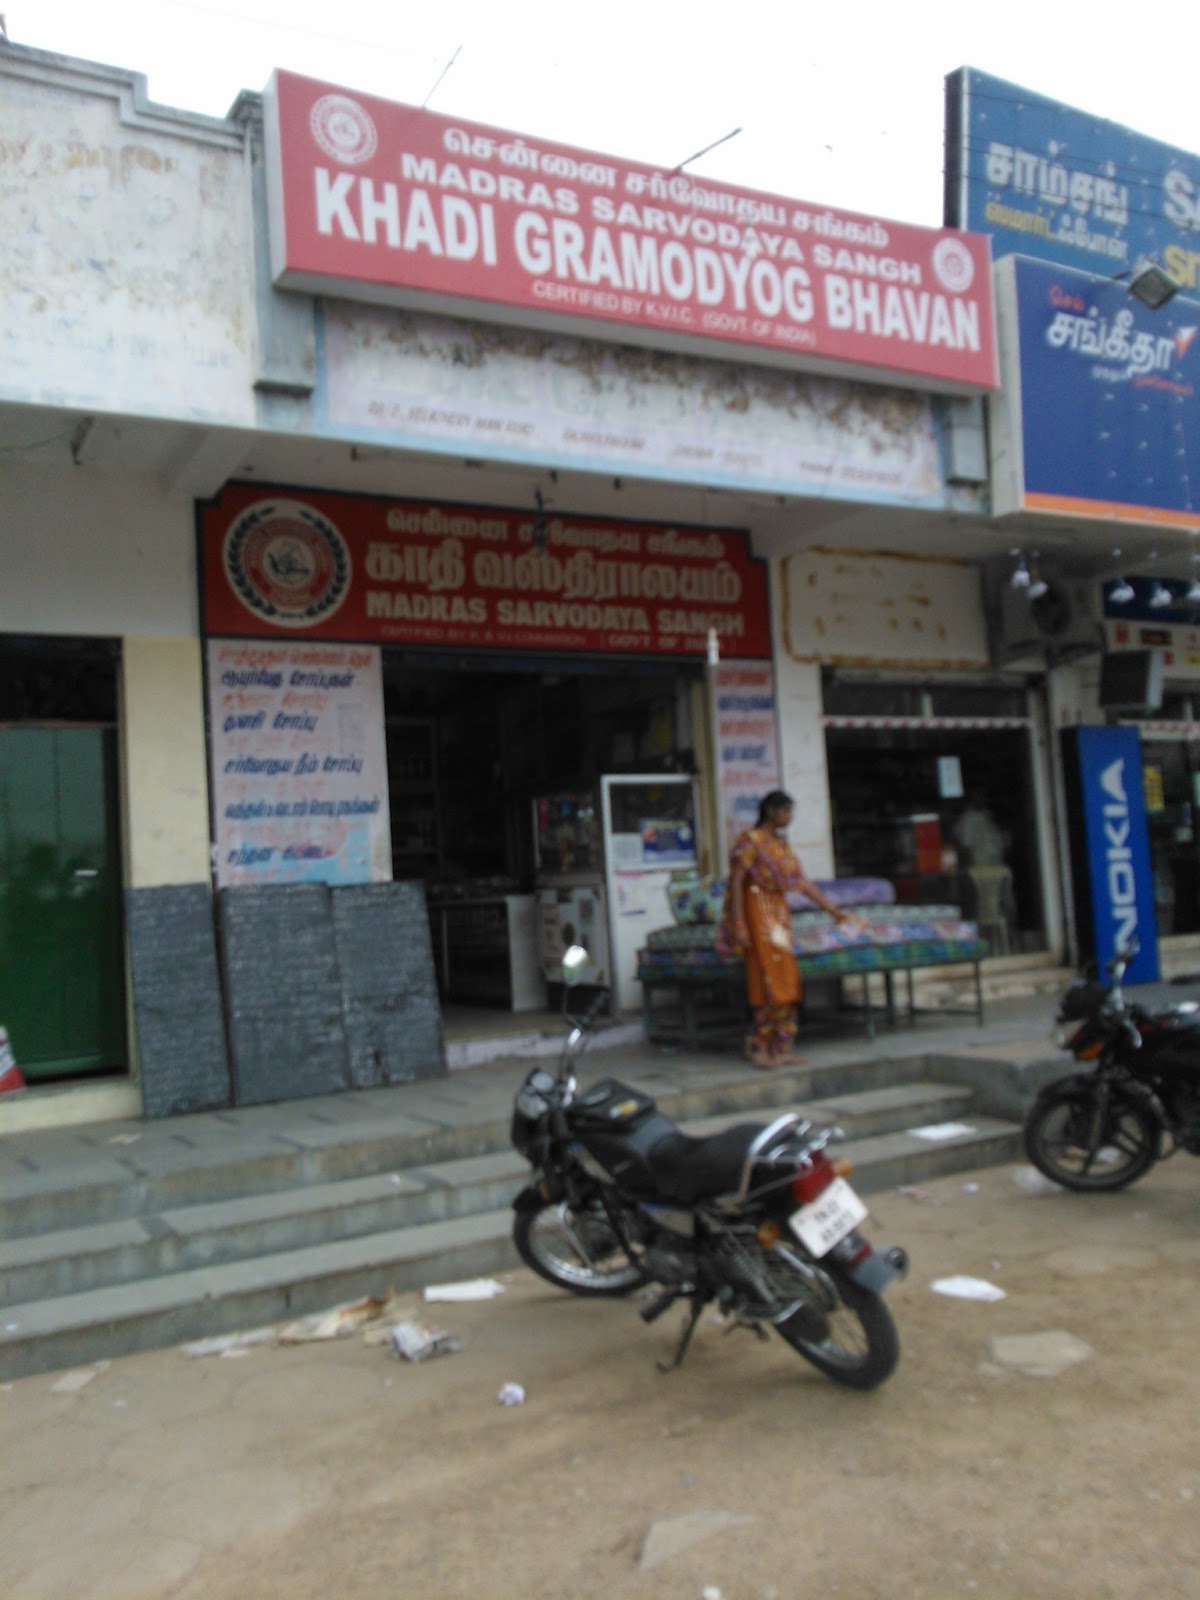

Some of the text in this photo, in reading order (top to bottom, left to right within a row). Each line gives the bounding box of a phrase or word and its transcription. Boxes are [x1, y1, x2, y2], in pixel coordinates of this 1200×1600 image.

[444, 126, 616, 191] சென்னை
[401, 152, 921, 284] MADRAS SARVODAYA SANGH
[1164, 169, 1200, 233] S
[314, 166, 981, 352] KHADI GRAMODYOG BHAVAN
[532, 280, 620, 312] CERTIFIED
[623, 298, 642, 316] BY
[752, 320, 771, 338] OF
[1048, 305, 1177, 379] சங்கீதா
[366, 591, 488, 624] MADRAS
[497, 599, 648, 633] SARVODAYA
[1100, 757, 1140, 953] NOKIA
